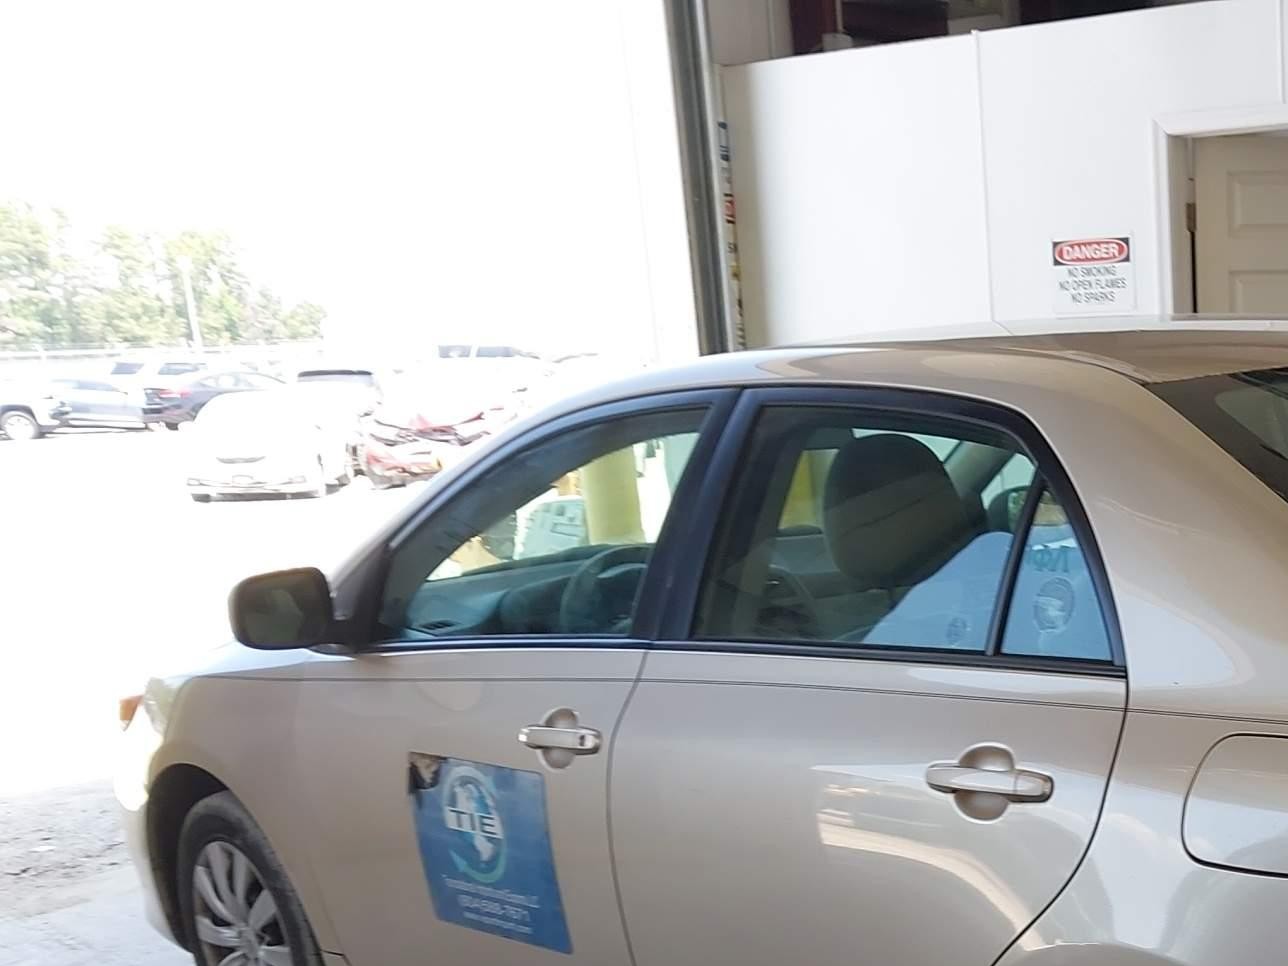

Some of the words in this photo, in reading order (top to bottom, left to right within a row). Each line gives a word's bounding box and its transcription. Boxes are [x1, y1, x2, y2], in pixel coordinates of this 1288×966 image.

[1062, 243, 1120, 260] DANGER
[1068, 267, 1078, 278] NO
[1080, 265, 1117, 278] SMOKING
[1059, 280, 1070, 291] NO
[1072, 279, 1093, 291] OPEN
[1096, 277, 1127, 290] FLAMES
[1071, 292, 1082, 303] NO
[1084, 291, 1116, 303] SPARKS
